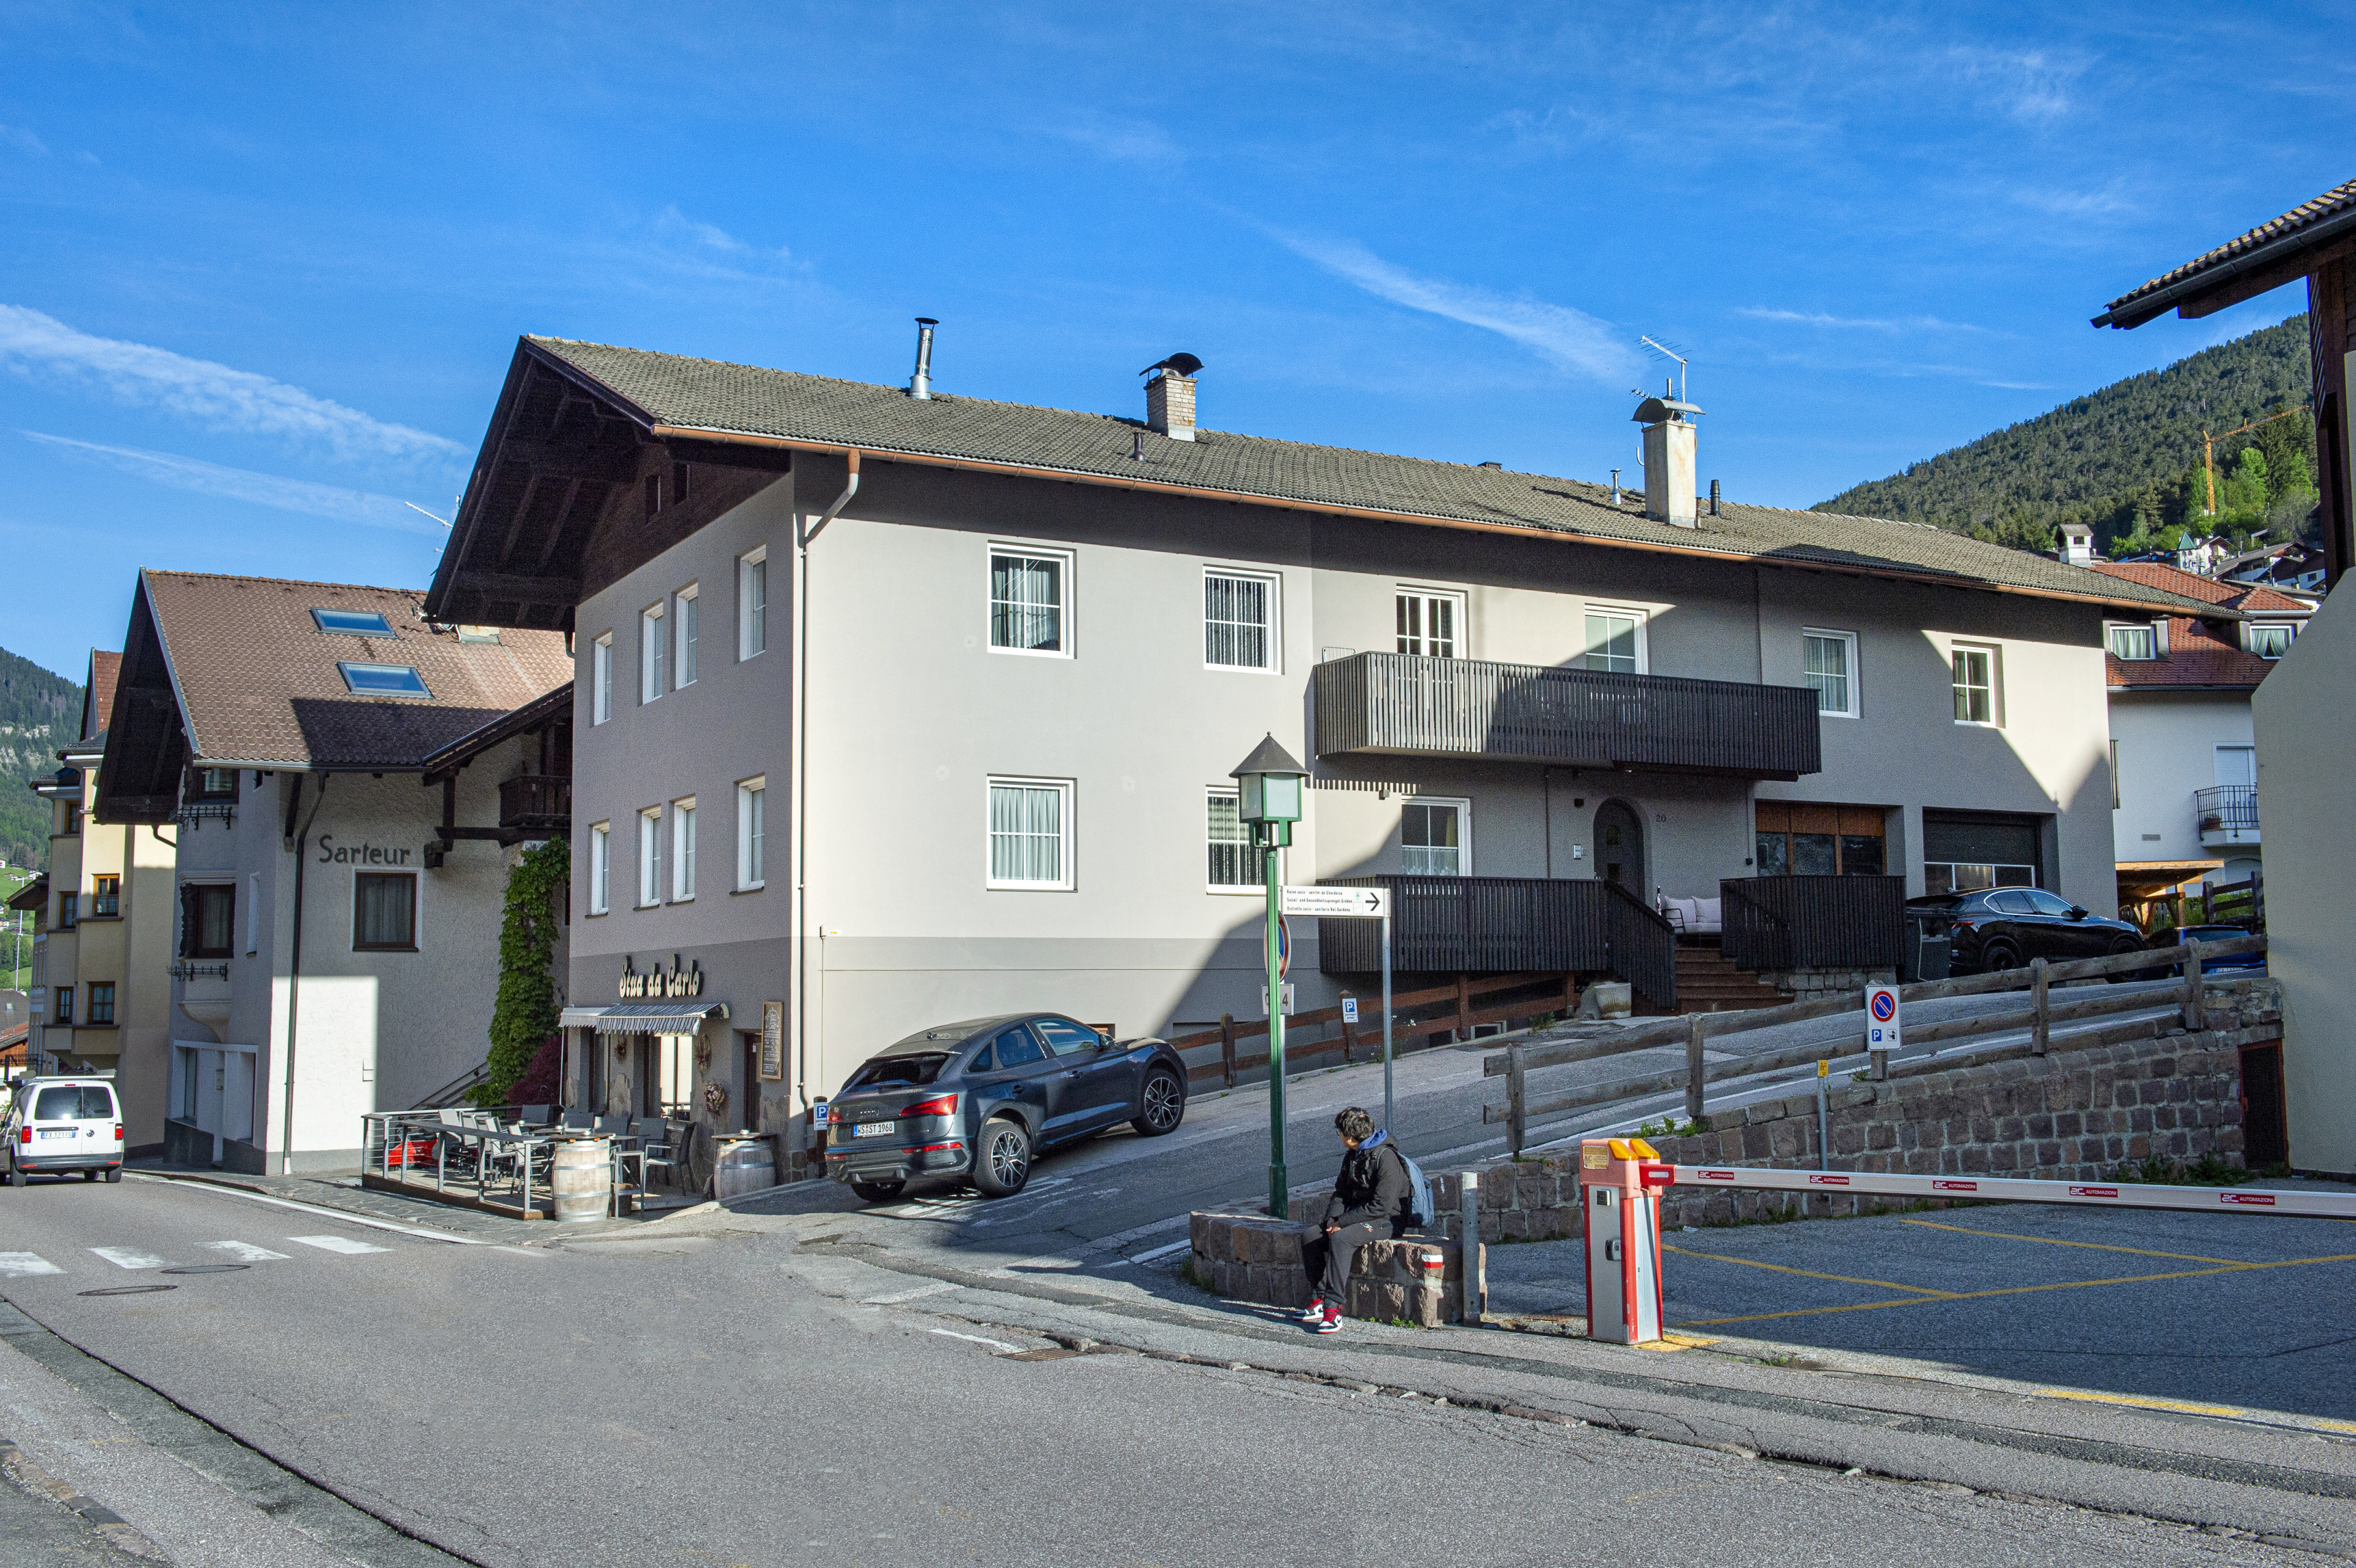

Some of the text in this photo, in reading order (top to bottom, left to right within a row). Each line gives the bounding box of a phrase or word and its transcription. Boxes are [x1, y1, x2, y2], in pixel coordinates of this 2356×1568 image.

[1656, 814, 1666, 822] 20
[319, 834, 411, 865] Sarteur
[619, 954, 700, 998] Stua da Carlo
[1346, 1002, 1353, 1012] P
[1874, 1030, 1880, 1041] P
[818, 1106, 827, 1118] P
[869, 1124, 876, 1134] ST
[878, 1123, 893, 1133] 1968
